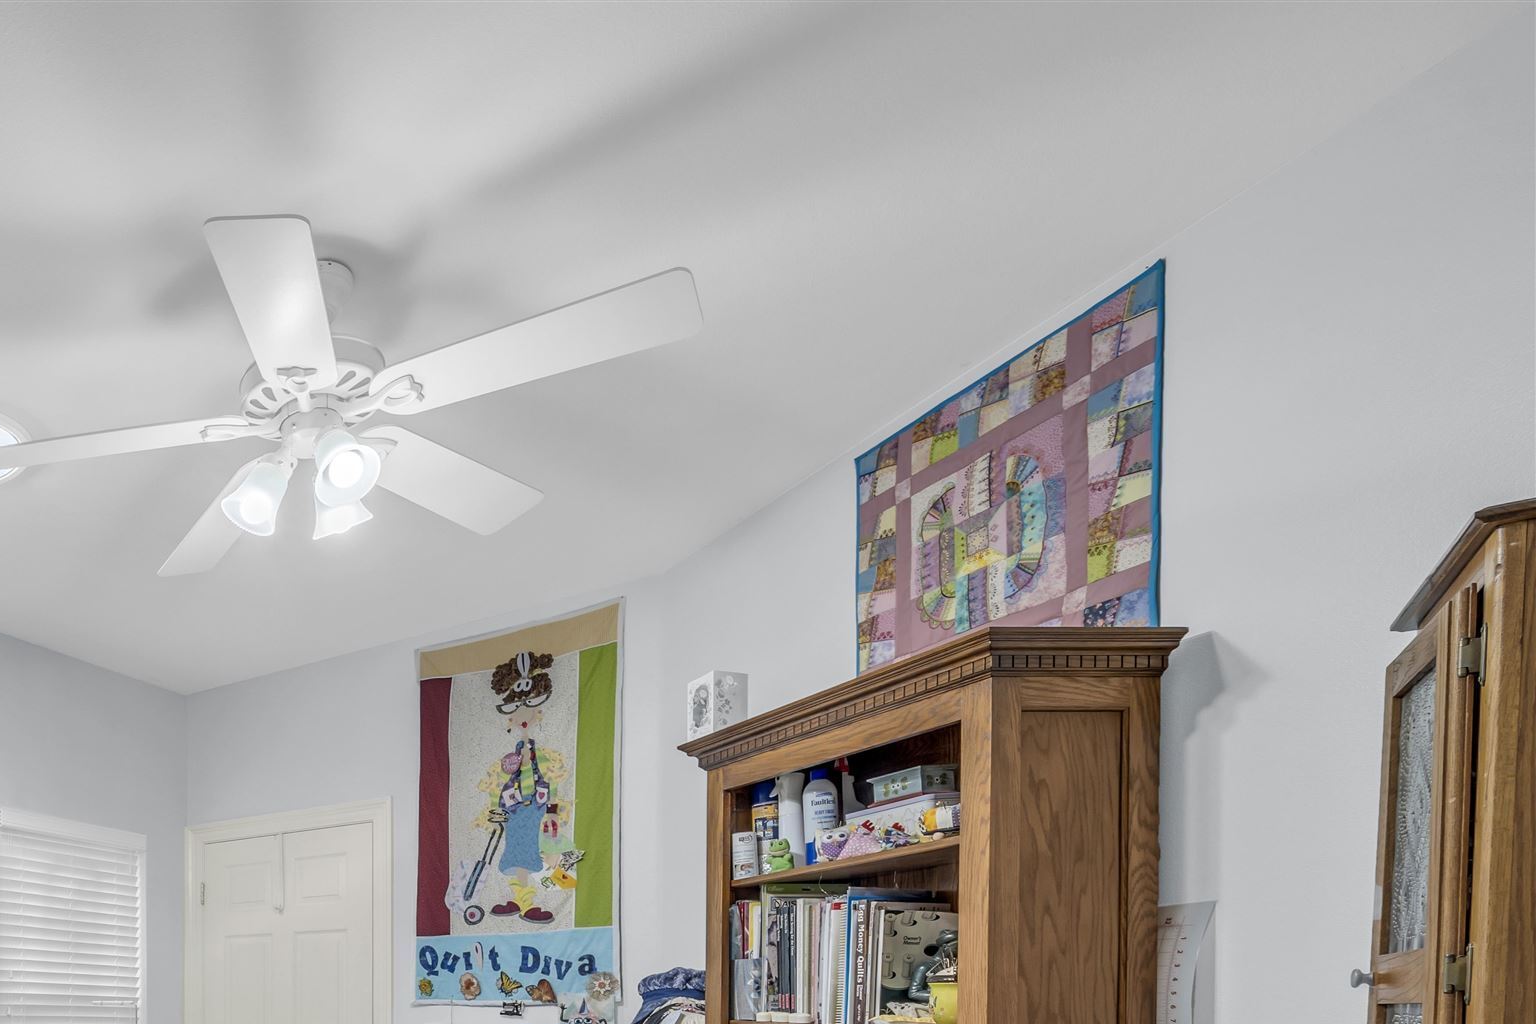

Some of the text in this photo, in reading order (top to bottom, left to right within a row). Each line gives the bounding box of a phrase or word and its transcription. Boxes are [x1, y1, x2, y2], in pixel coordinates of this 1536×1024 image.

[519, 945, 598, 980] Diva
[857, 904, 865, 985] Egg Money Quilts
